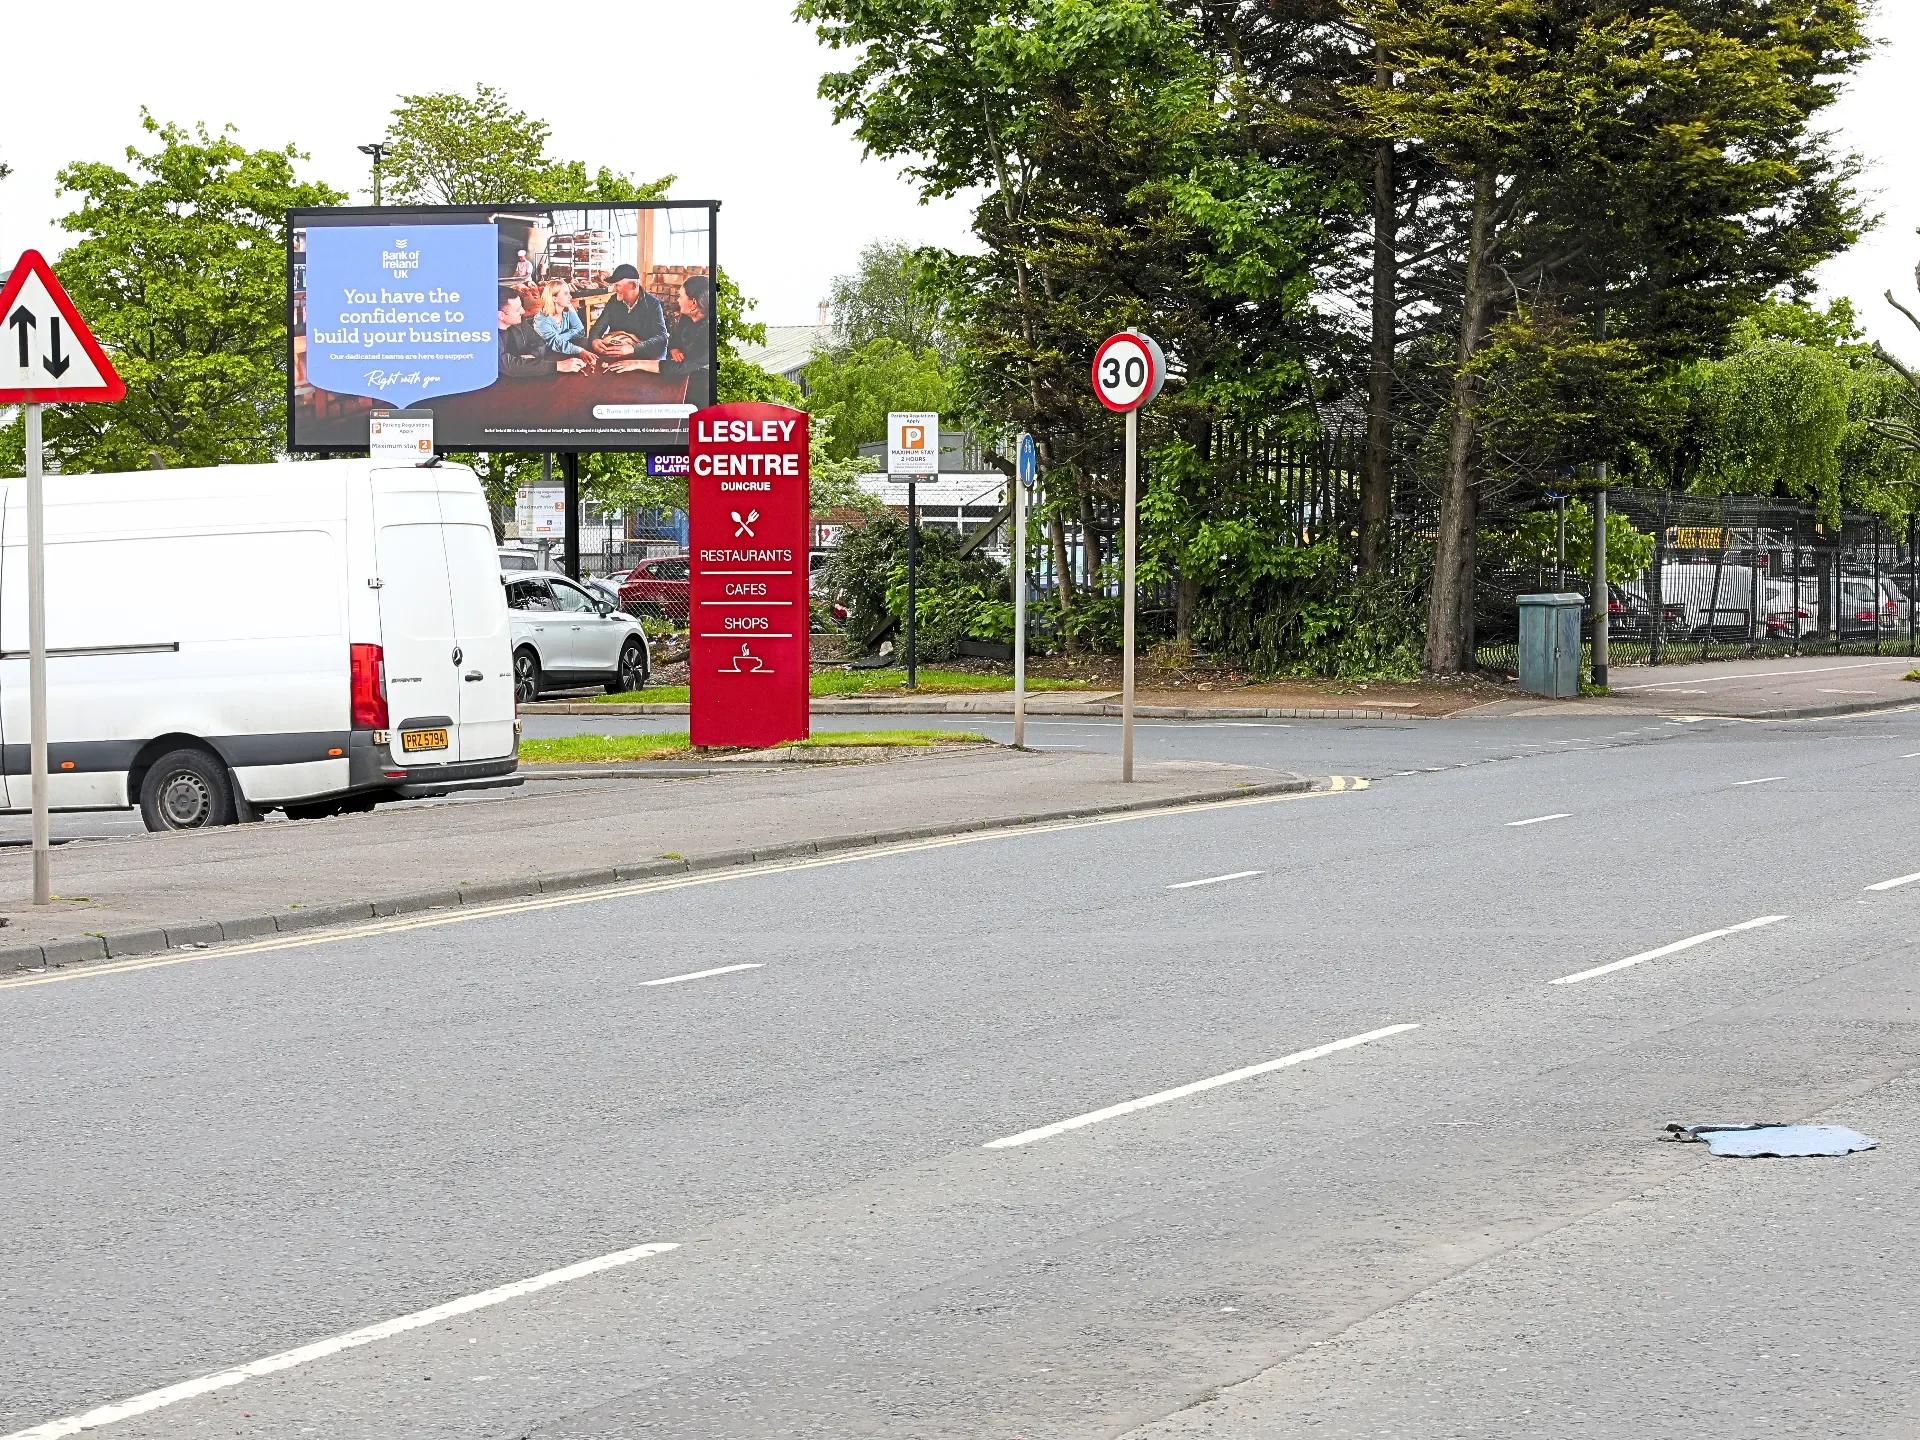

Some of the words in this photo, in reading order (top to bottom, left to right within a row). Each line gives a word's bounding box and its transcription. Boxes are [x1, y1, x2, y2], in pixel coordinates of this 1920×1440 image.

[383, 251, 408, 260] Bank
[409, 251, 420, 260] of
[383, 260, 419, 269] Ireland
[394, 270, 409, 279] UK
[344, 289, 377, 304] You
[381, 288, 424, 304] have
[429, 288, 460, 303] the
[340, 308, 440, 324] confidence
[445, 310, 464, 323] to
[314, 328, 359, 344] build
[363, 331, 406, 347] your
[409, 328, 491, 343] business
[444, 353, 474, 361] support
[1102, 357, 1145, 389] 30
[363, 370, 400, 390] Right
[401, 371, 420, 385] with
[423, 375, 440, 389] you
[698, 420, 796, 443] LESLEY
[421, 441, 428, 449] 2
[693, 453, 799, 476] CENTRE
[721, 482, 771, 491] DUNCRUE
[700, 549, 792, 562] RESTAURANTS
[725, 583, 767, 595] CAFES
[724, 617, 769, 630] SHOPS
[407, 734, 422, 748] PRZ
[425, 732, 445, 746] 5794
